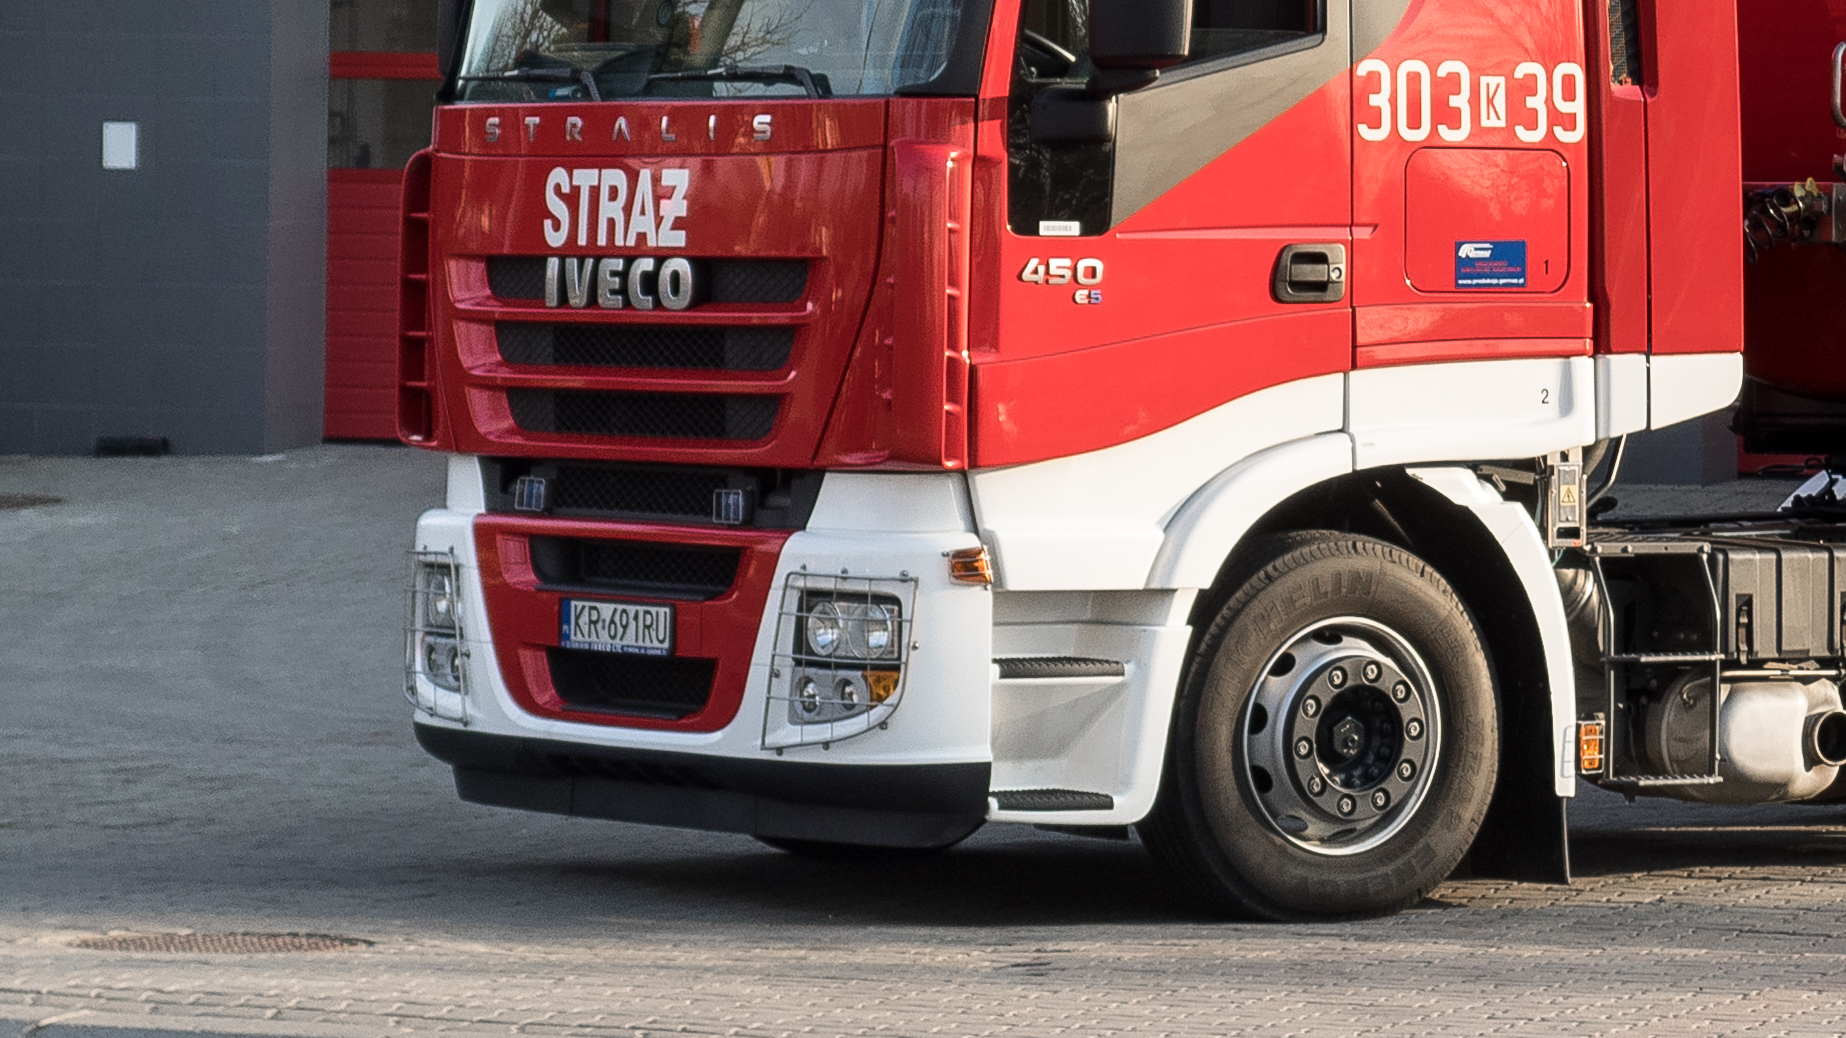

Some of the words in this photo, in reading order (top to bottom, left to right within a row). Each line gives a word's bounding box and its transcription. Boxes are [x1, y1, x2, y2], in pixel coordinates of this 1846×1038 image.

[1356, 58, 1472, 142] 303
[1486, 81, 1502, 122] K
[1513, 61, 1585, 144] 39
[484, 114, 775, 143] STRALIS
[1020, 256, 1105, 286] 450
[1543, 259, 1549, 275] 1
[545, 256, 693, 310] IVECO
[1541, 388, 1549, 405] 2
[574, 604, 600, 640] KR
[607, 607, 667, 645] 691RU
